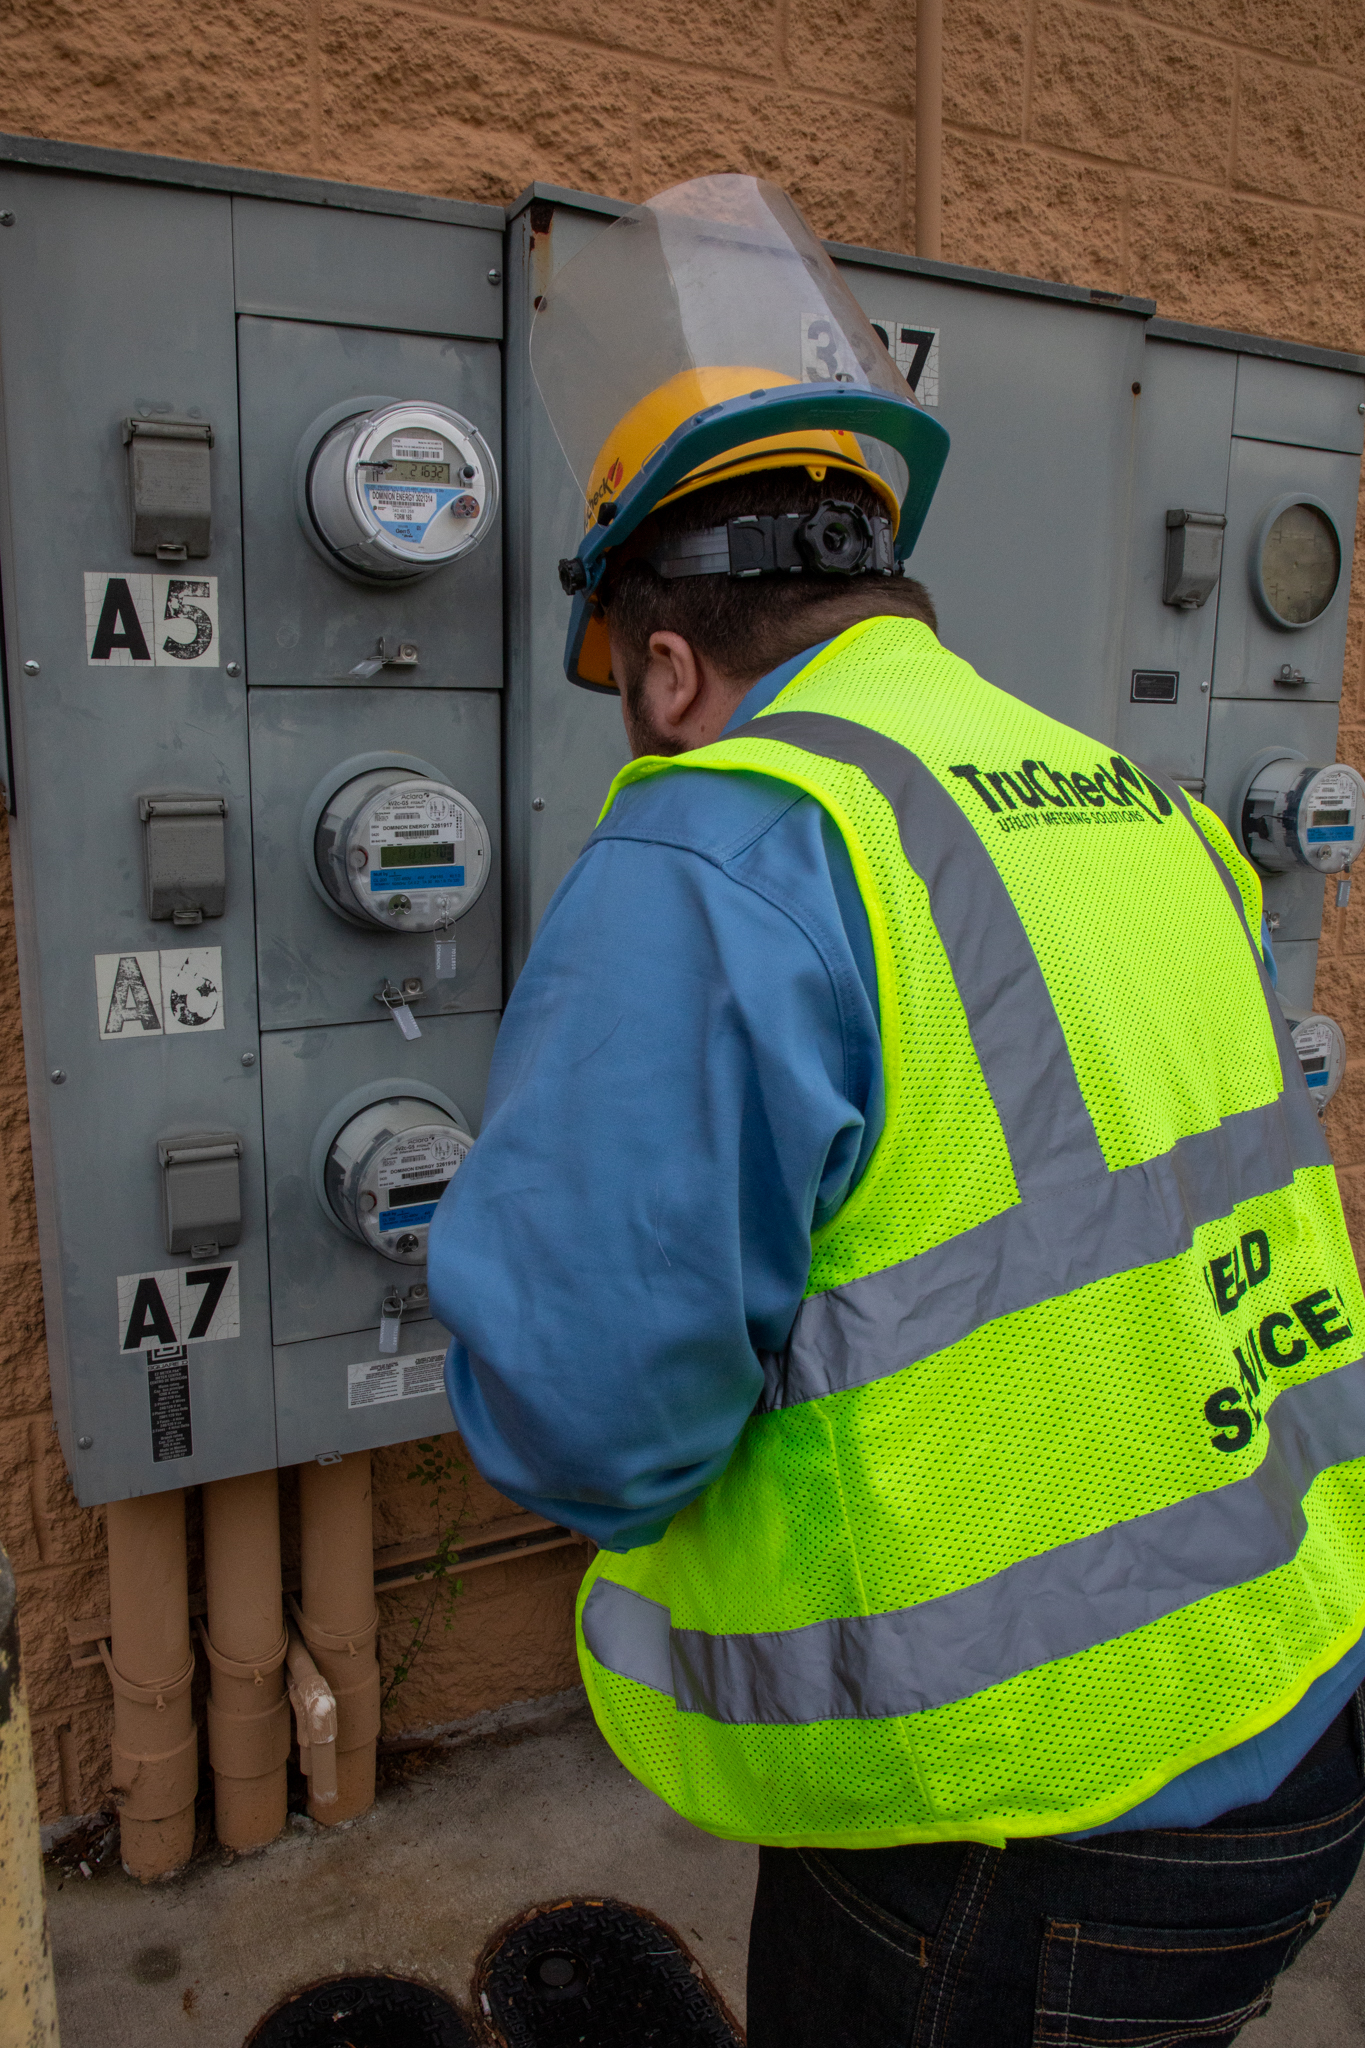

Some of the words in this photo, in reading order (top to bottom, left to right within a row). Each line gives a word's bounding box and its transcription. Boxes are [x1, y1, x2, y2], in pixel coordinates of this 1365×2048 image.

[410, 464, 444, 479] 21632
[372, 491, 395, 500] DOMINION
[396, 492, 415, 501] ENERGY
[91, 578, 212, 660] A5
[948, 759, 1134, 814] TruCheck
[997, 812, 1040, 832] UTILITY
[1041, 812, 1092, 827] METERING
[1092, 810, 1144, 824] SOLUTIONS
[123, 1266, 232, 1350] A7
